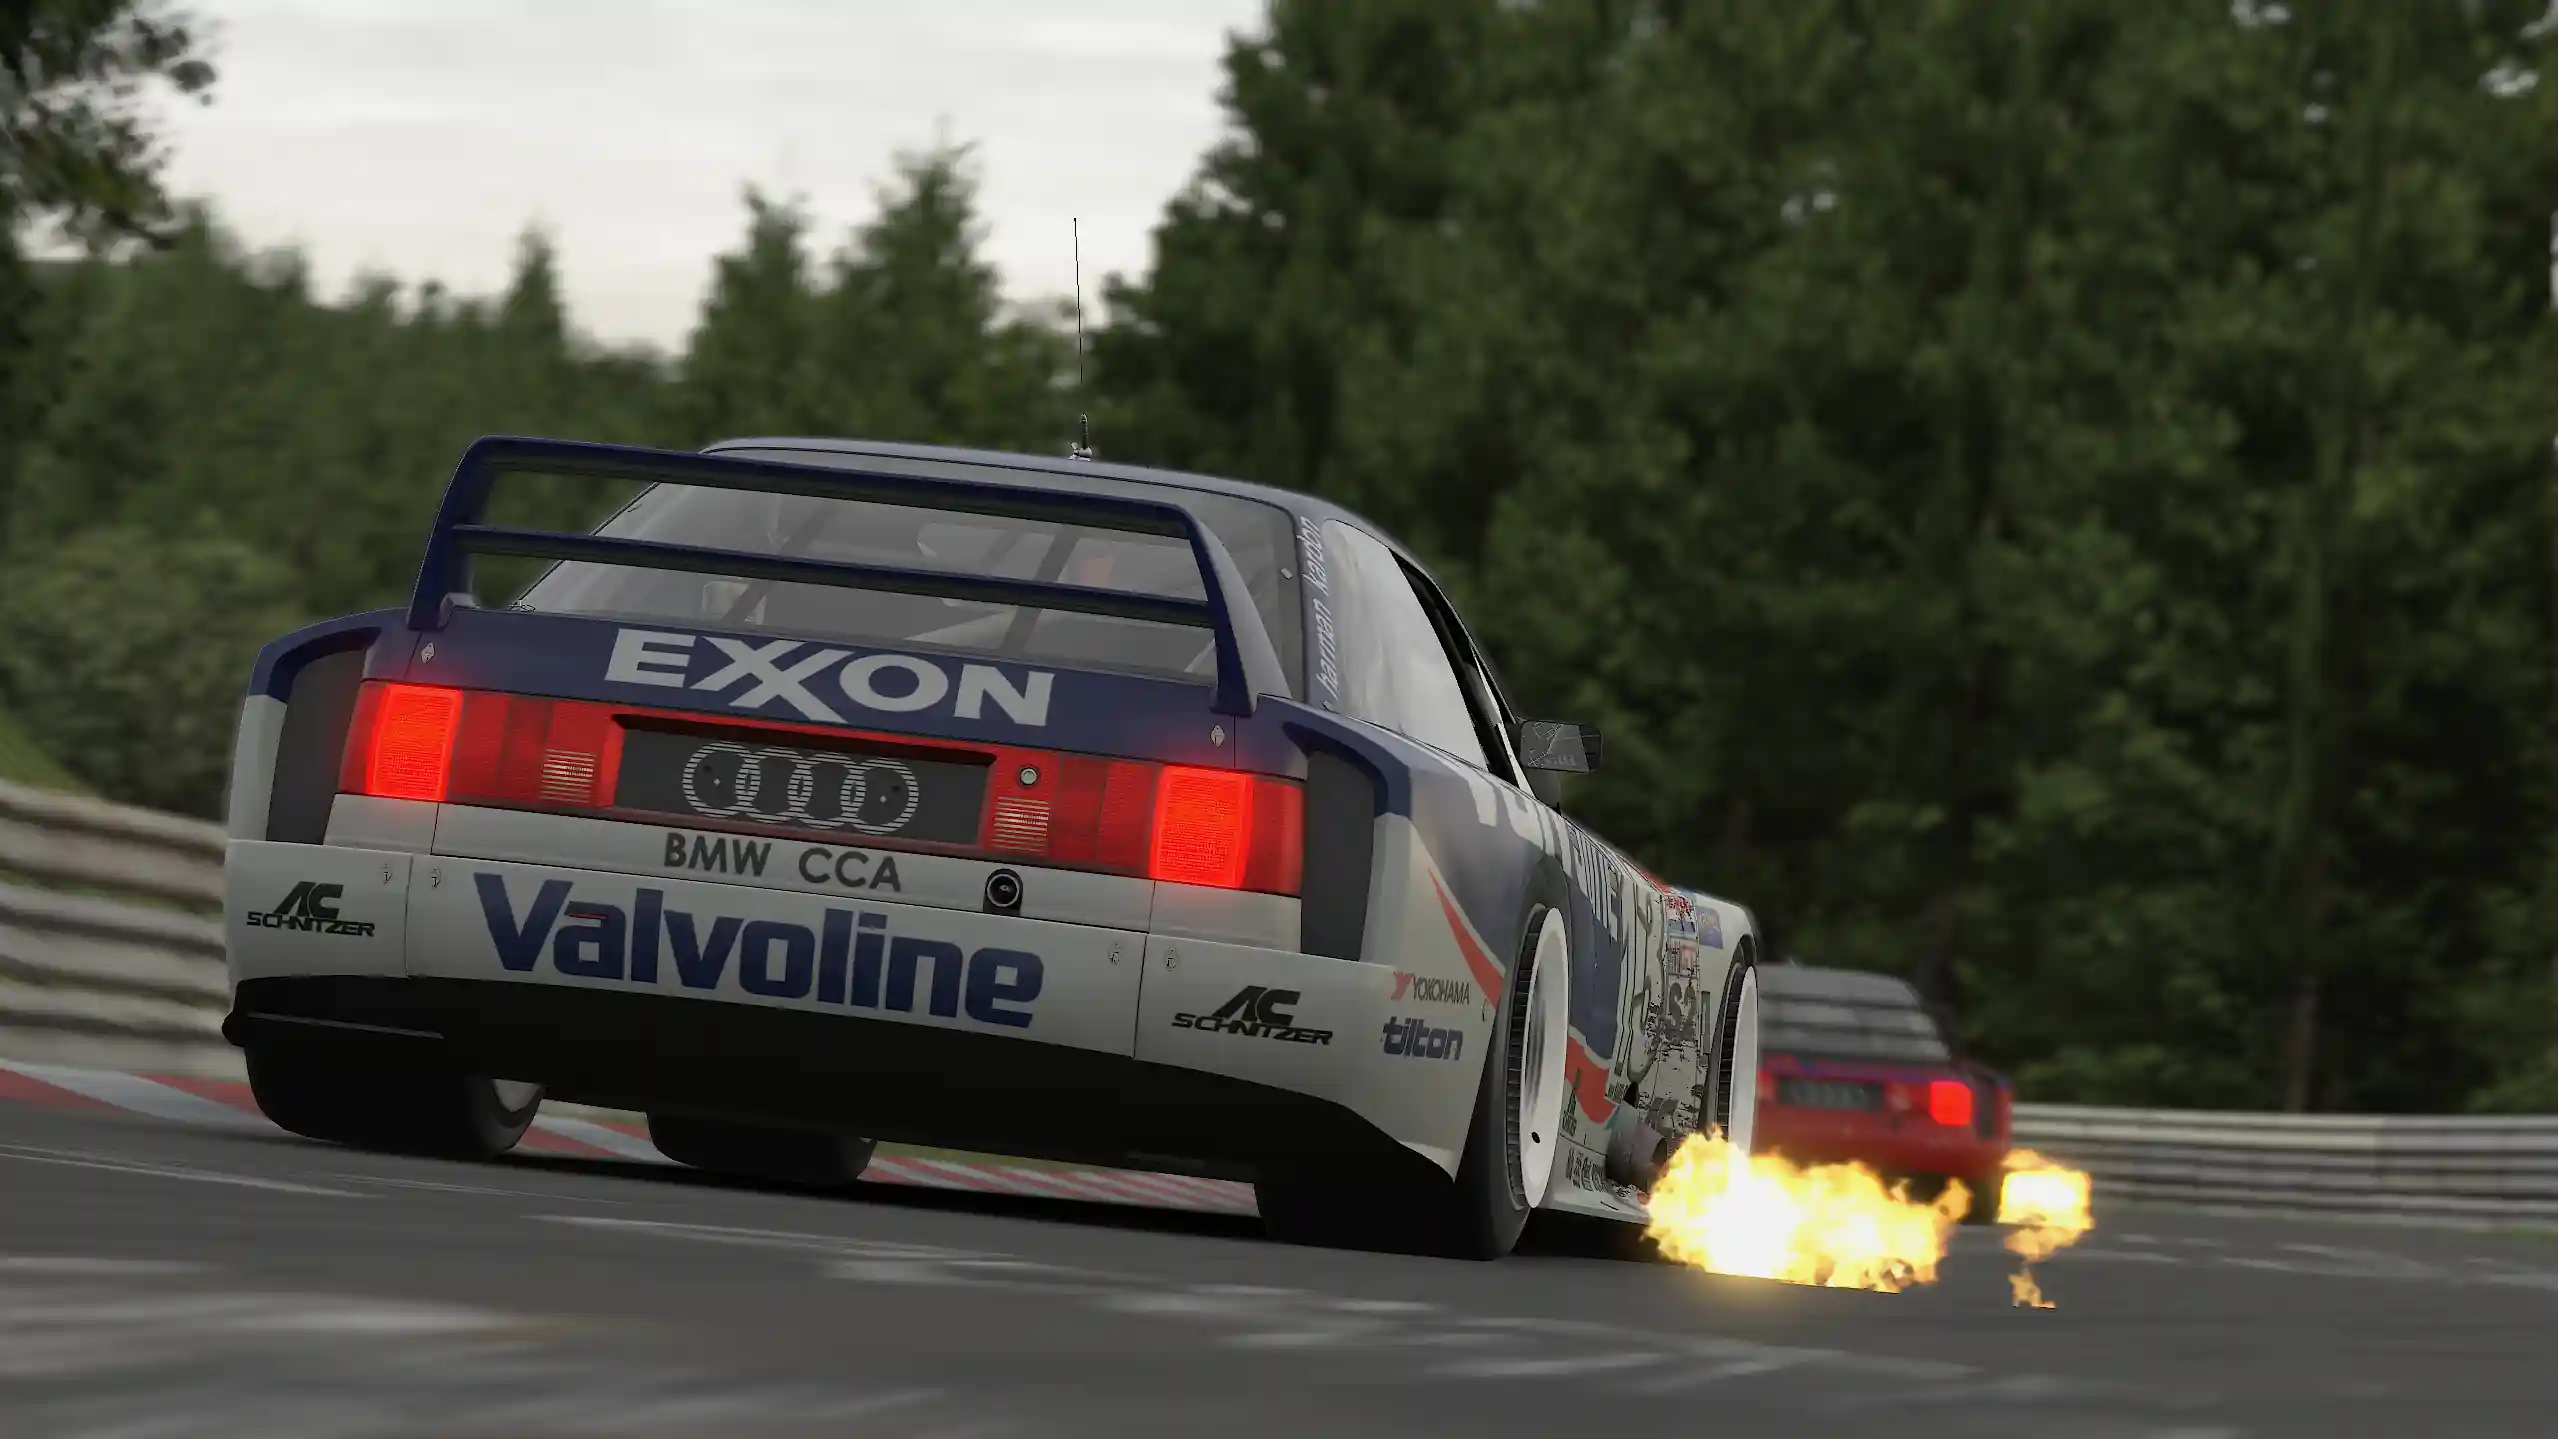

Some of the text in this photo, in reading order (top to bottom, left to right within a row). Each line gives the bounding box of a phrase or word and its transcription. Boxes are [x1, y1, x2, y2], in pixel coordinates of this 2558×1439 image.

[1296, 515, 1339, 700] harman kardon
[604, 628, 1056, 726] EXXON
[664, 832, 901, 893] BMW CCA
[273, 881, 344, 919] AC
[246, 911, 376, 937] SCHNITZER
[473, 872, 1045, 1028] Valvoline
[1211, 985, 1301, 1027] AC
[1412, 975, 1470, 1005] YOKOHAMA
[1171, 1013, 1334, 1046] SCHNITZER
[1383, 1016, 1464, 1060] tilton
